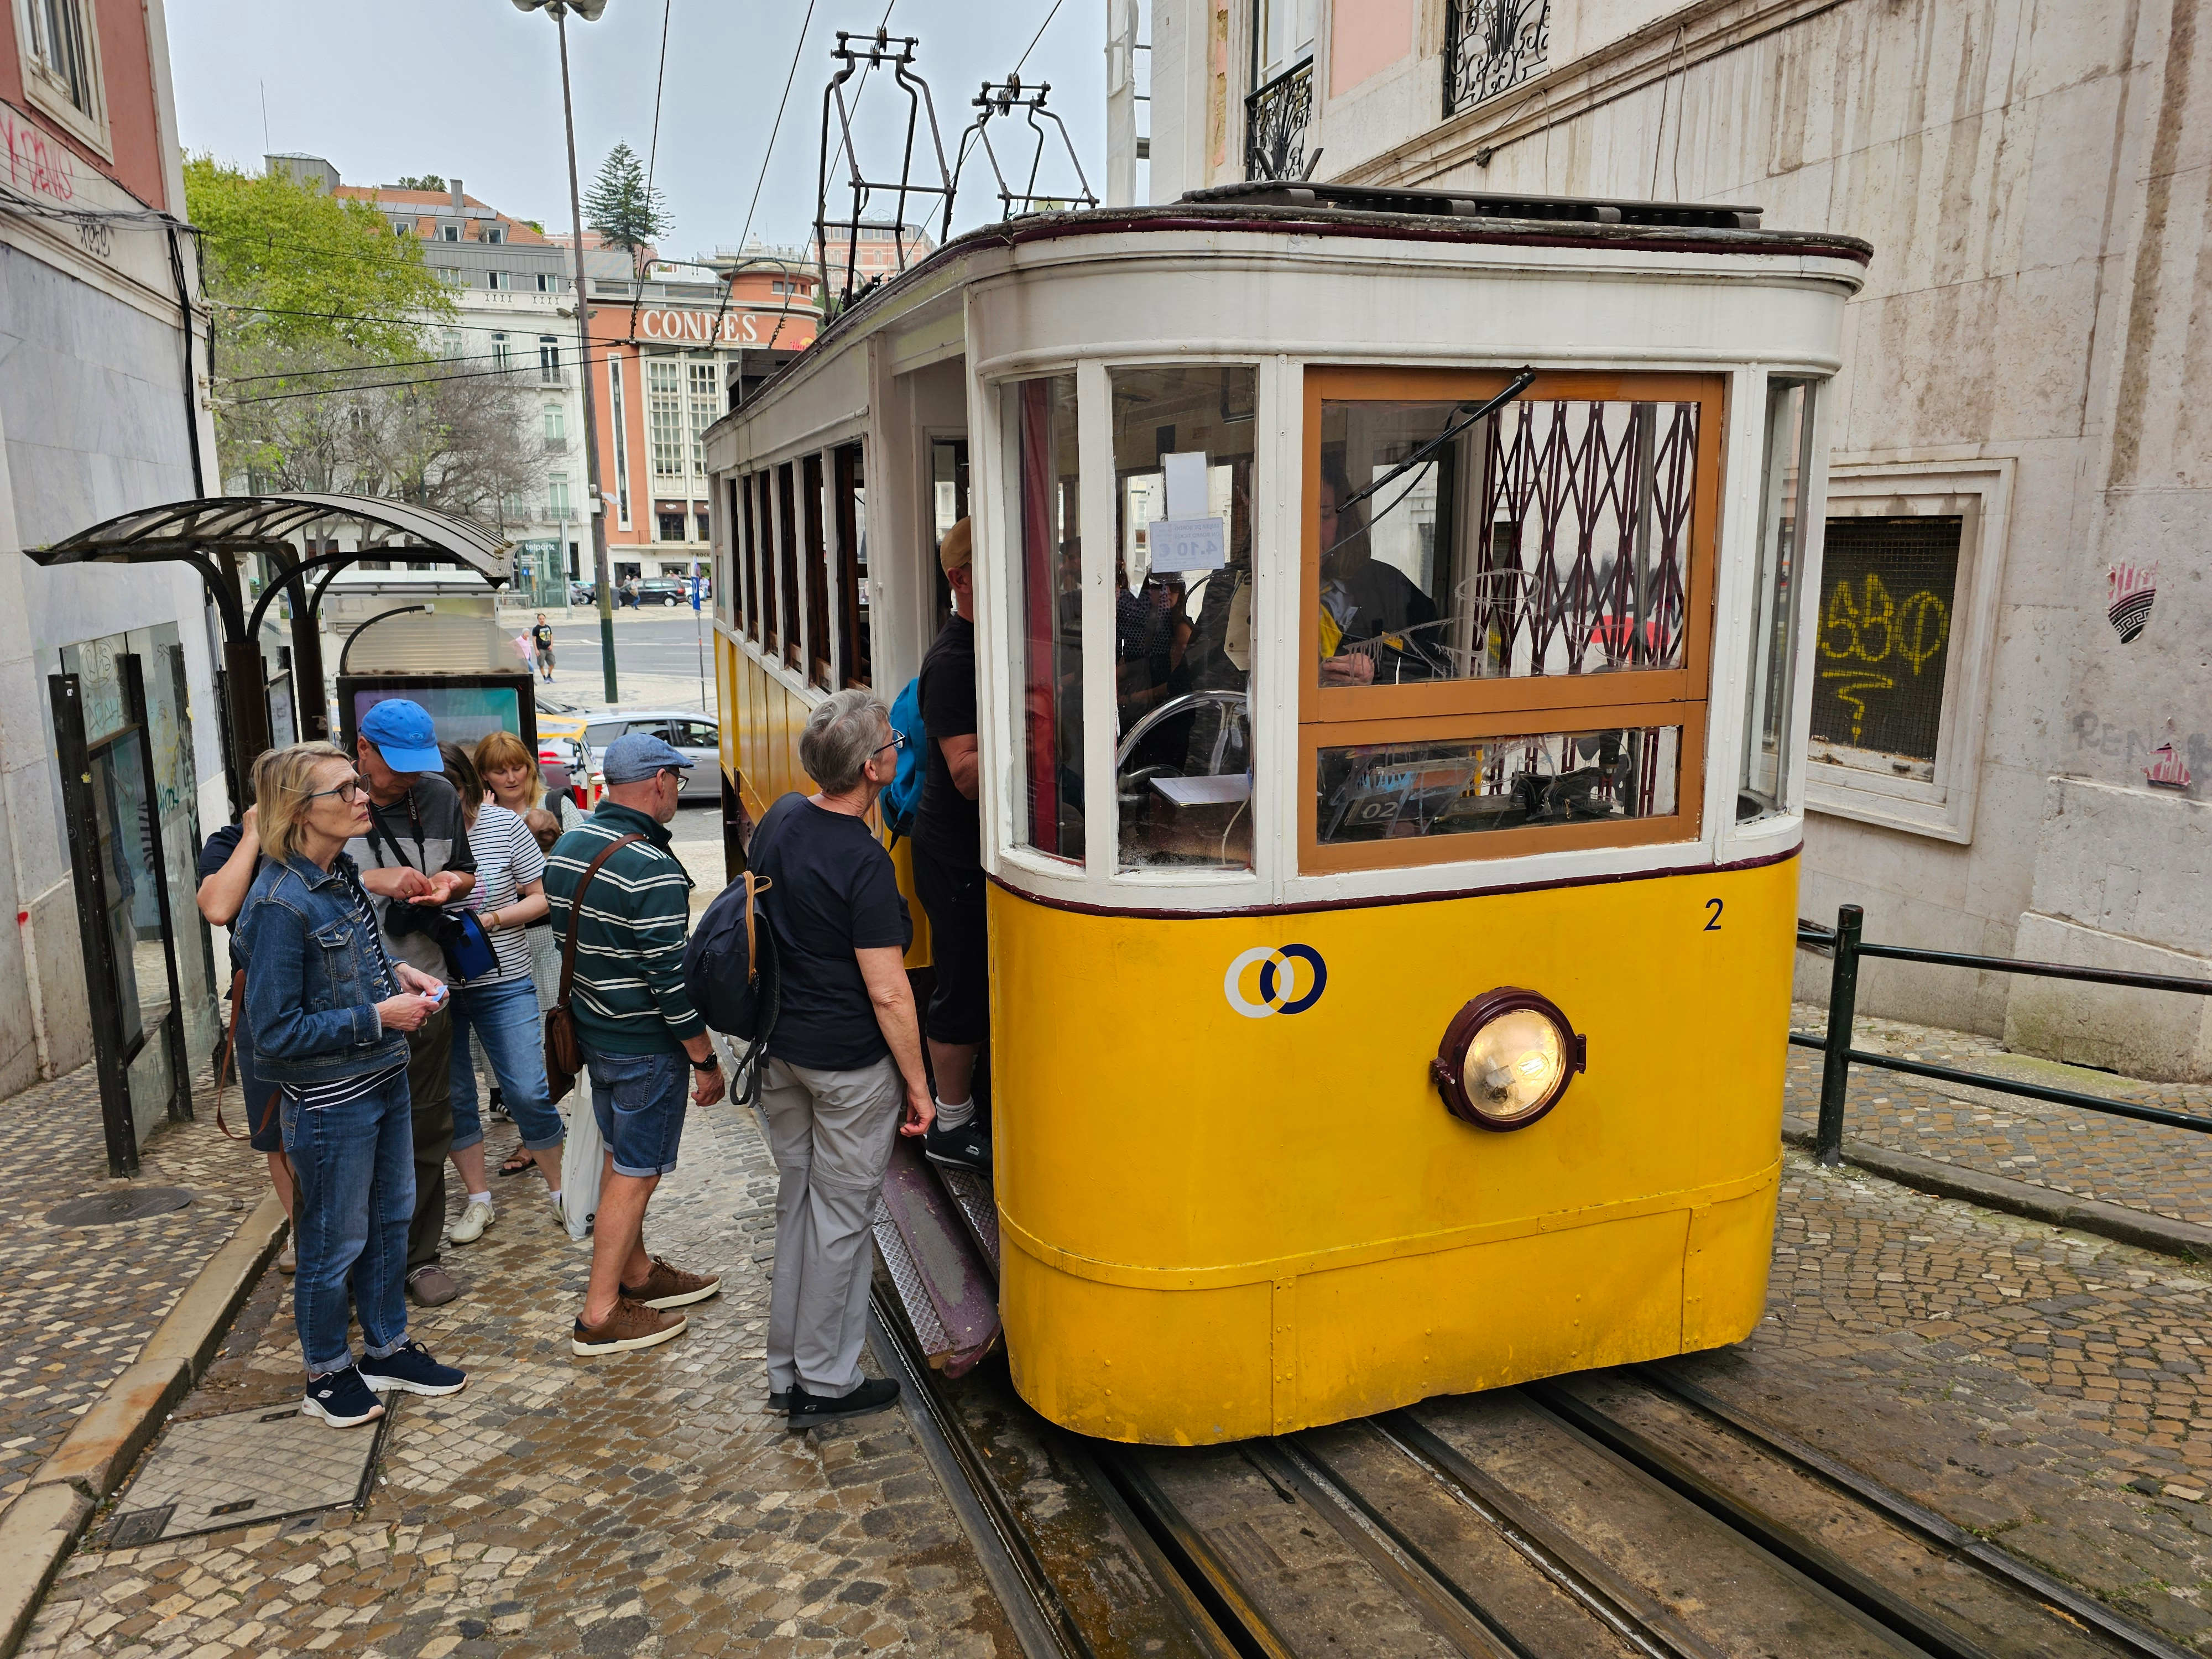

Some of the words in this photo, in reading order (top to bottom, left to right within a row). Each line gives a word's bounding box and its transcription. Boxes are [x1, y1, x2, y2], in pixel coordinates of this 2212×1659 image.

[642, 310, 757, 342] CONDES
[525, 543, 555, 552] telpark
[1362, 801, 1399, 819] 02
[1703, 898, 1723, 931] 2
